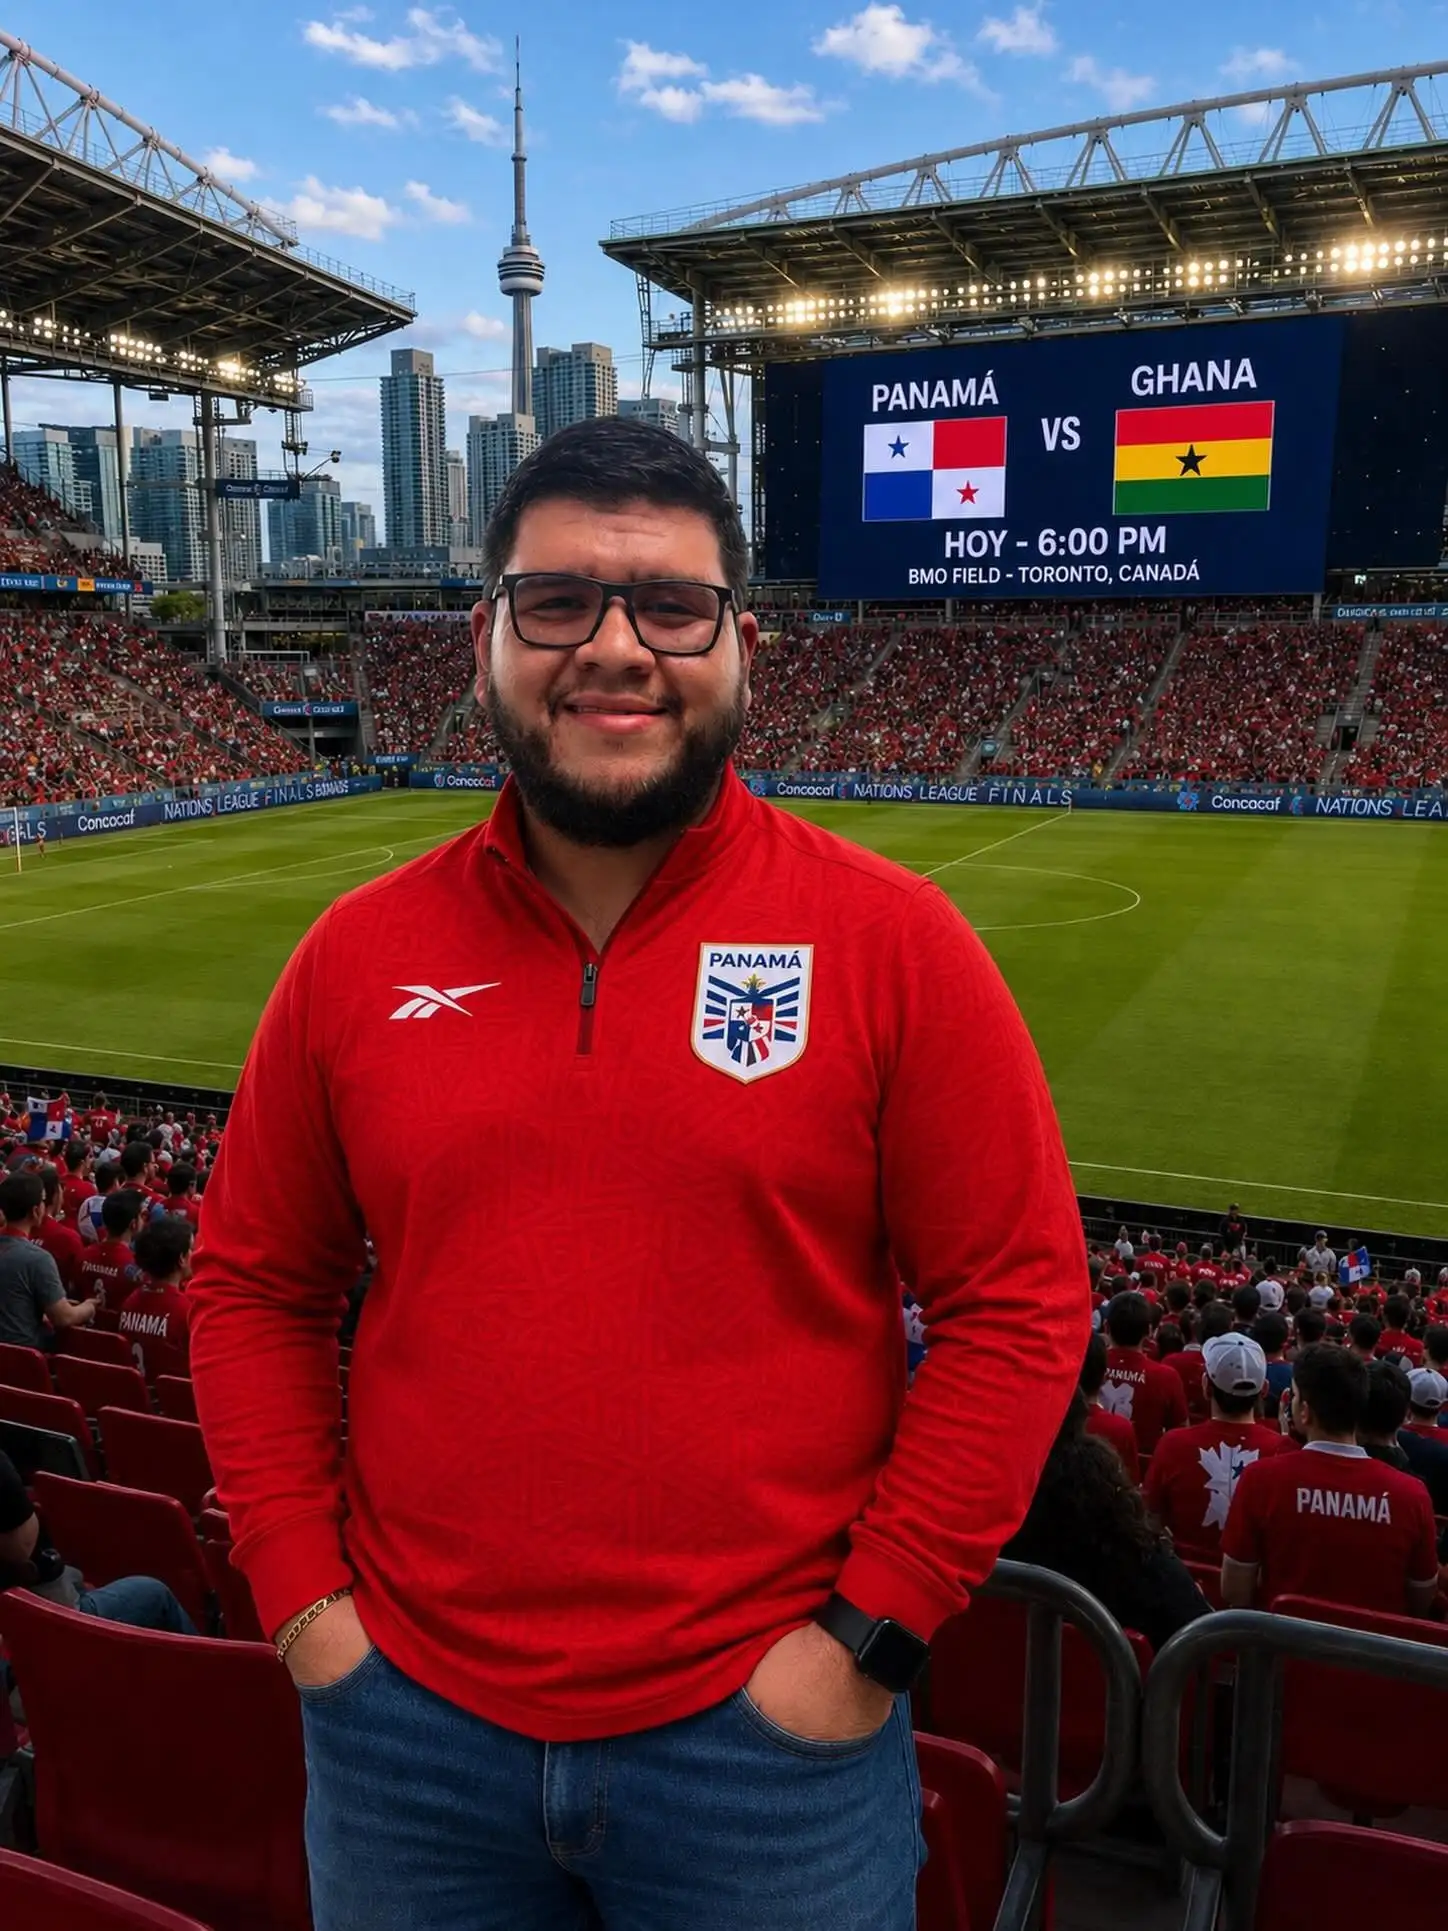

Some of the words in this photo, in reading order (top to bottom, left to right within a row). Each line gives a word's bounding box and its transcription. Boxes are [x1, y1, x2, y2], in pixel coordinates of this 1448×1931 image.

[872, 370, 999, 412] PANAMÁ
[1131, 358, 1257, 396] GHANA
[1041, 416, 1081, 451] VS
[945, 530, 1008, 558] HOY
[1038, 528, 1109, 556] 6:00
[1118, 526, 1166, 554] PM
[908, 568, 948, 584] BMO
[952, 567, 1001, 584] FIELD
[1018, 565, 1113, 585] TORONTO,
[1118, 558, 1200, 582] CANADÁ
[164, 798, 213, 820] NATIONS
[217, 791, 260, 813] LEAGUE
[853, 783, 913, 799] NATIONS
[919, 785, 978, 801] LEAGUE
[988, 787, 1073, 805] FINALS
[1315, 797, 1393, 815] NATIONS
[1402, 799, 1448, 817] LEA
[709, 950, 802, 969] PANAMÁ
[1296, 1488, 1392, 1525] PANAMÁ
